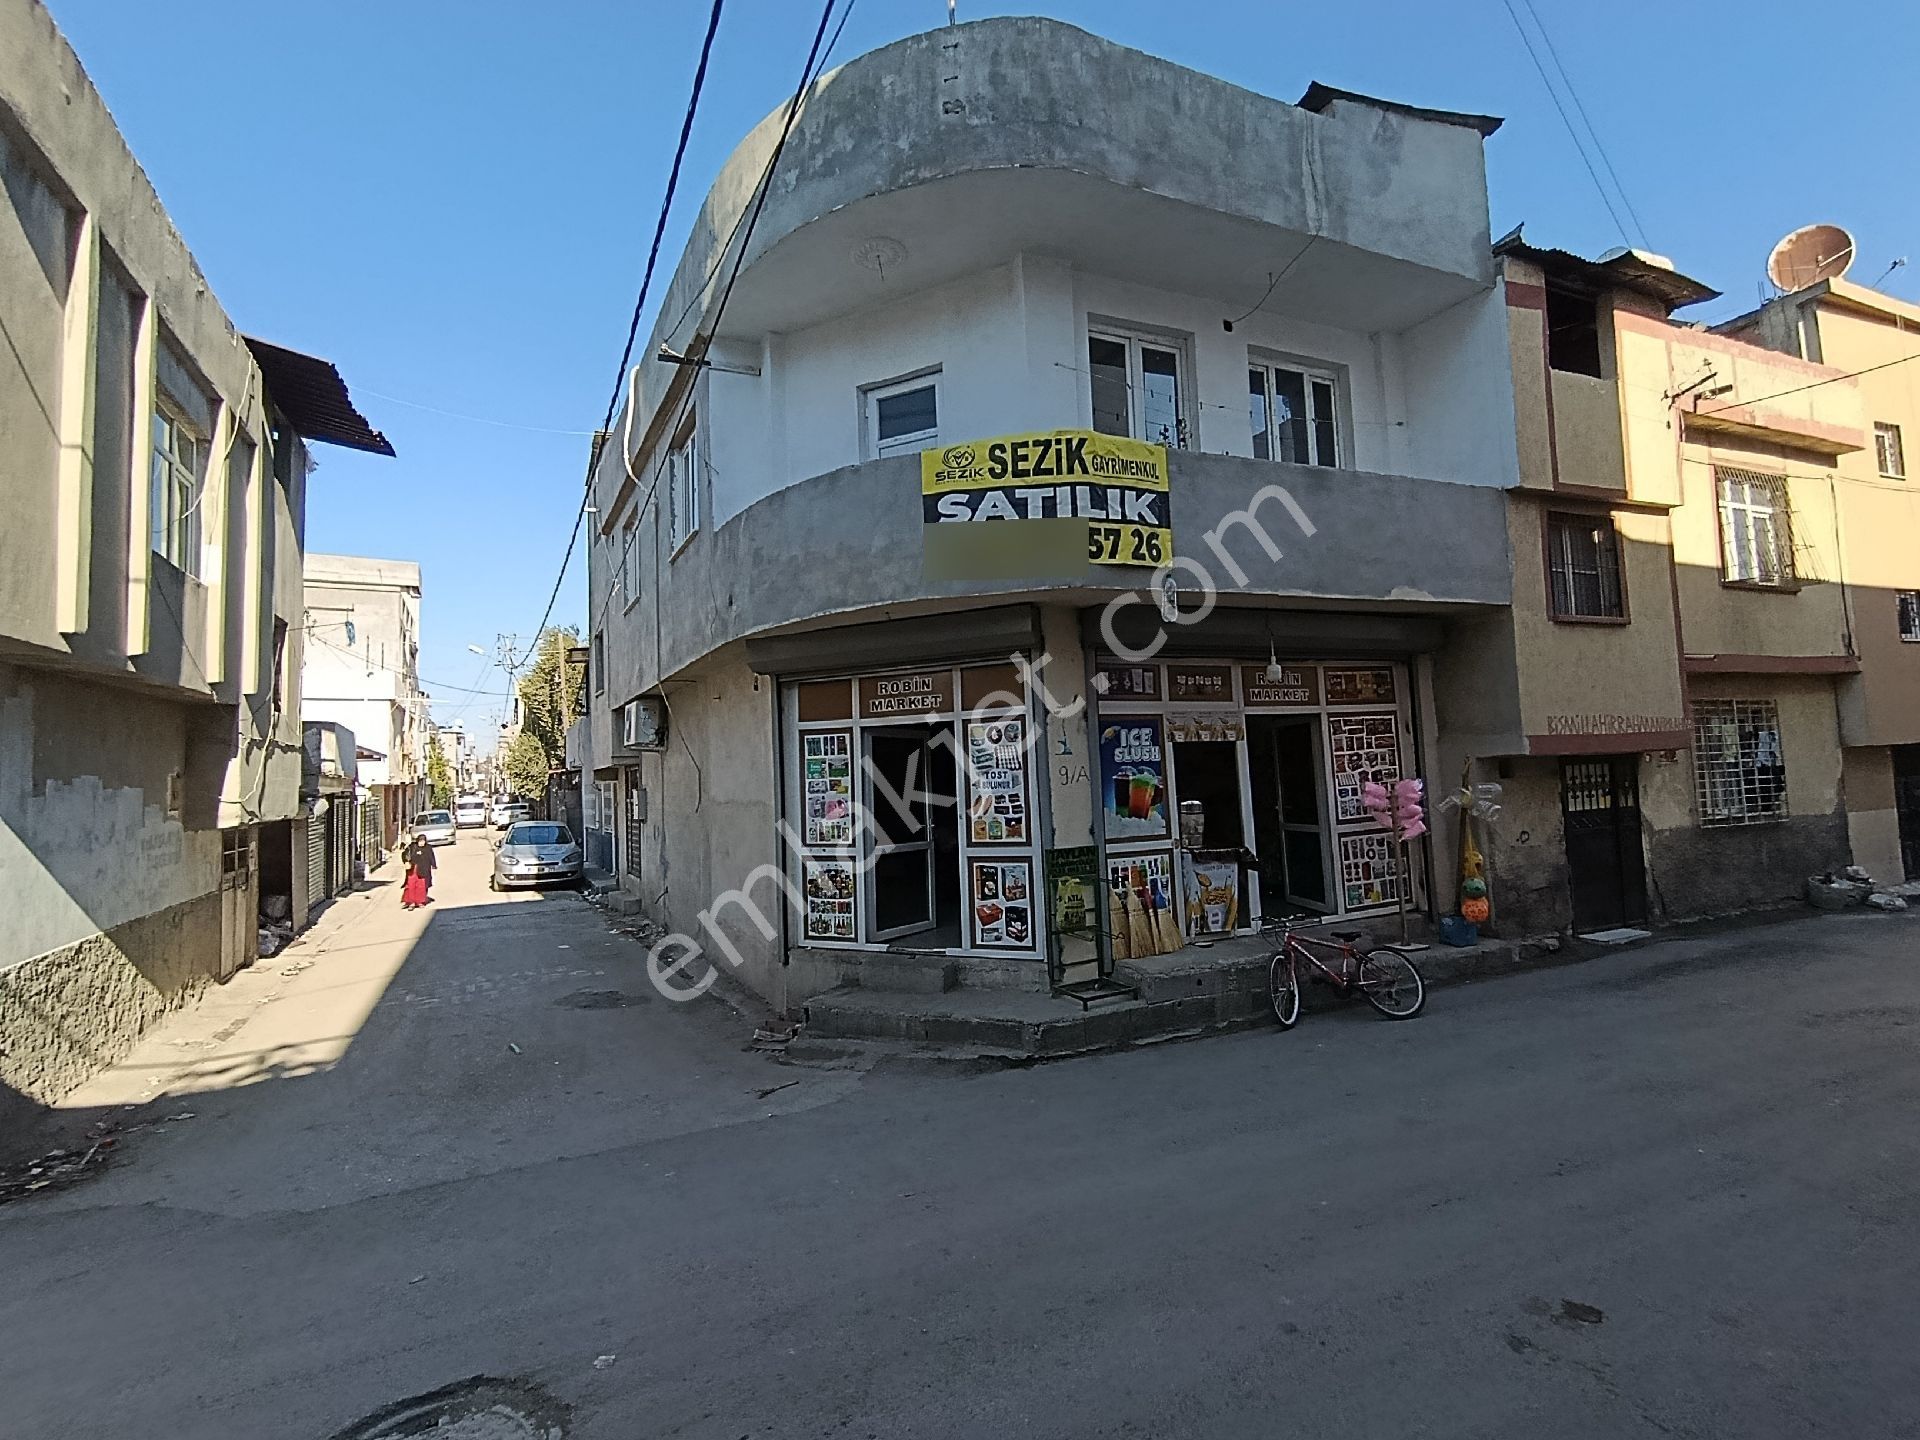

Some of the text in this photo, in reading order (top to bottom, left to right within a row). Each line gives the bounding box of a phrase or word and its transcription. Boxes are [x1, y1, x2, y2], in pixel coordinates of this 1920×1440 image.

[937, 485, 1159, 525] SATILIK
[1088, 527, 1162, 563] 57 26
[869, 693, 943, 712] MARKET
[1249, 688, 1310, 702] MARKET
[1120, 728, 1153, 747] ICE
[1114, 746, 1162, 763] SLUSH
[984, 770, 1009, 780] TOST
[1058, 765, 1090, 786] 9/A
